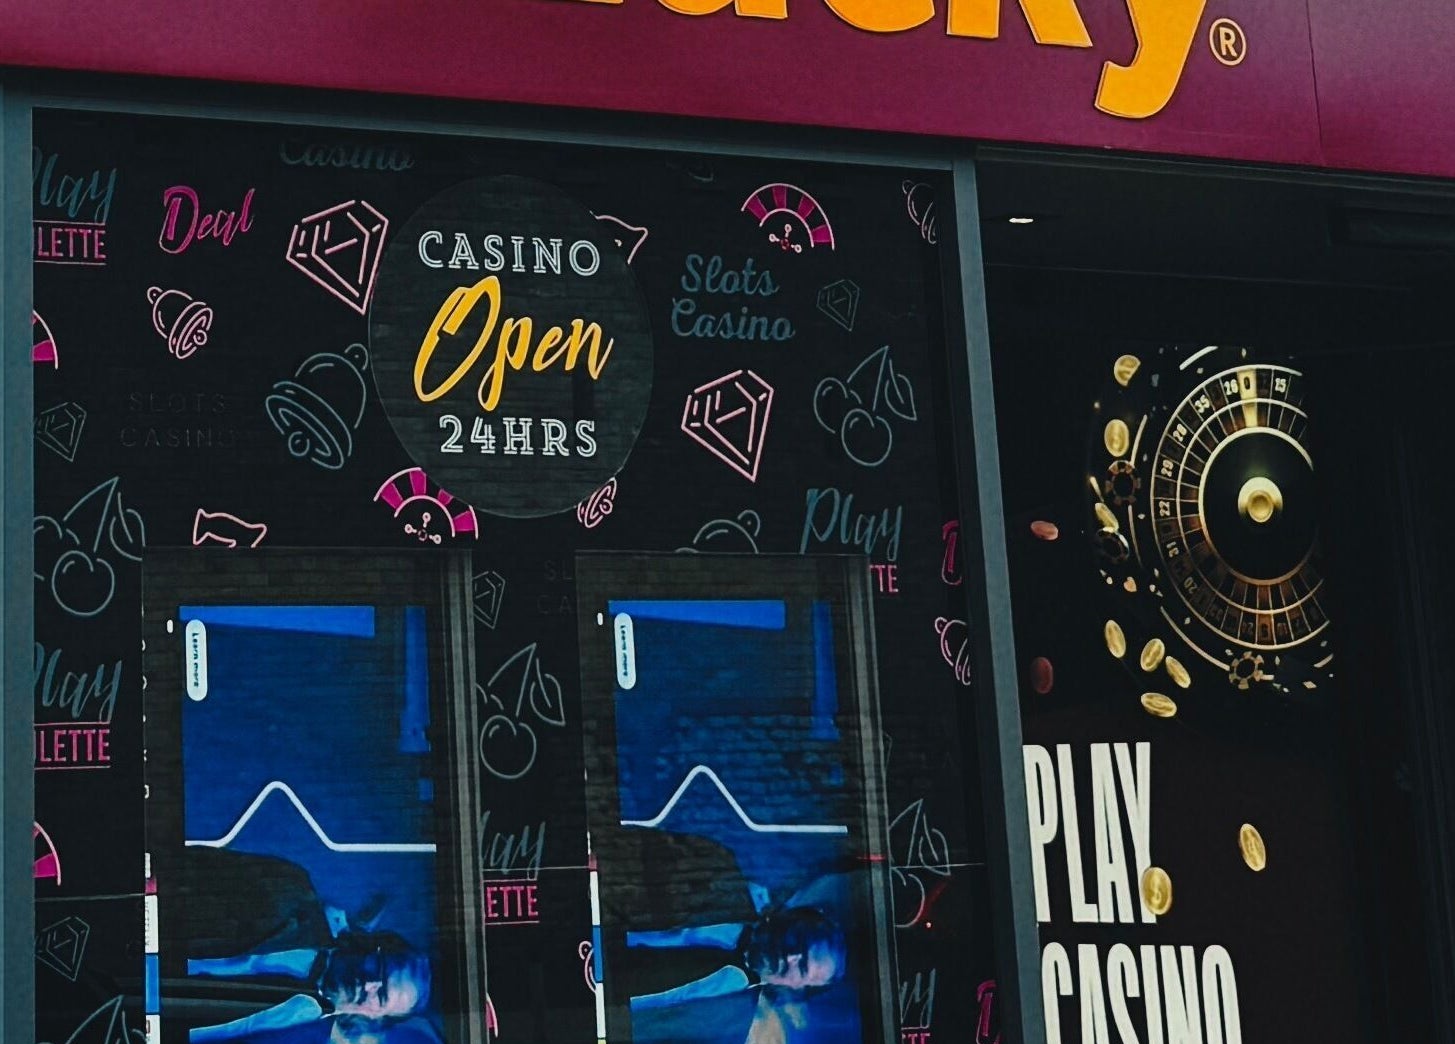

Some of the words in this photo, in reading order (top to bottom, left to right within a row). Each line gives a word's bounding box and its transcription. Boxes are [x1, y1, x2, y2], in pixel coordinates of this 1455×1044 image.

[38, 226, 106, 259] LETTE
[159, 186, 256, 255] Deal
[419, 231, 601, 276] CASINO
[680, 254, 780, 297] Slots
[671, 298, 796, 341] Casino
[414, 275, 614, 411] Open
[440, 415, 597, 457] 24HRS
[800, 487, 903, 562] Play
[40, 728, 111, 762] LETTE
[481, 810, 547, 880] lay
[1022, 741, 1157, 923] PLAY
